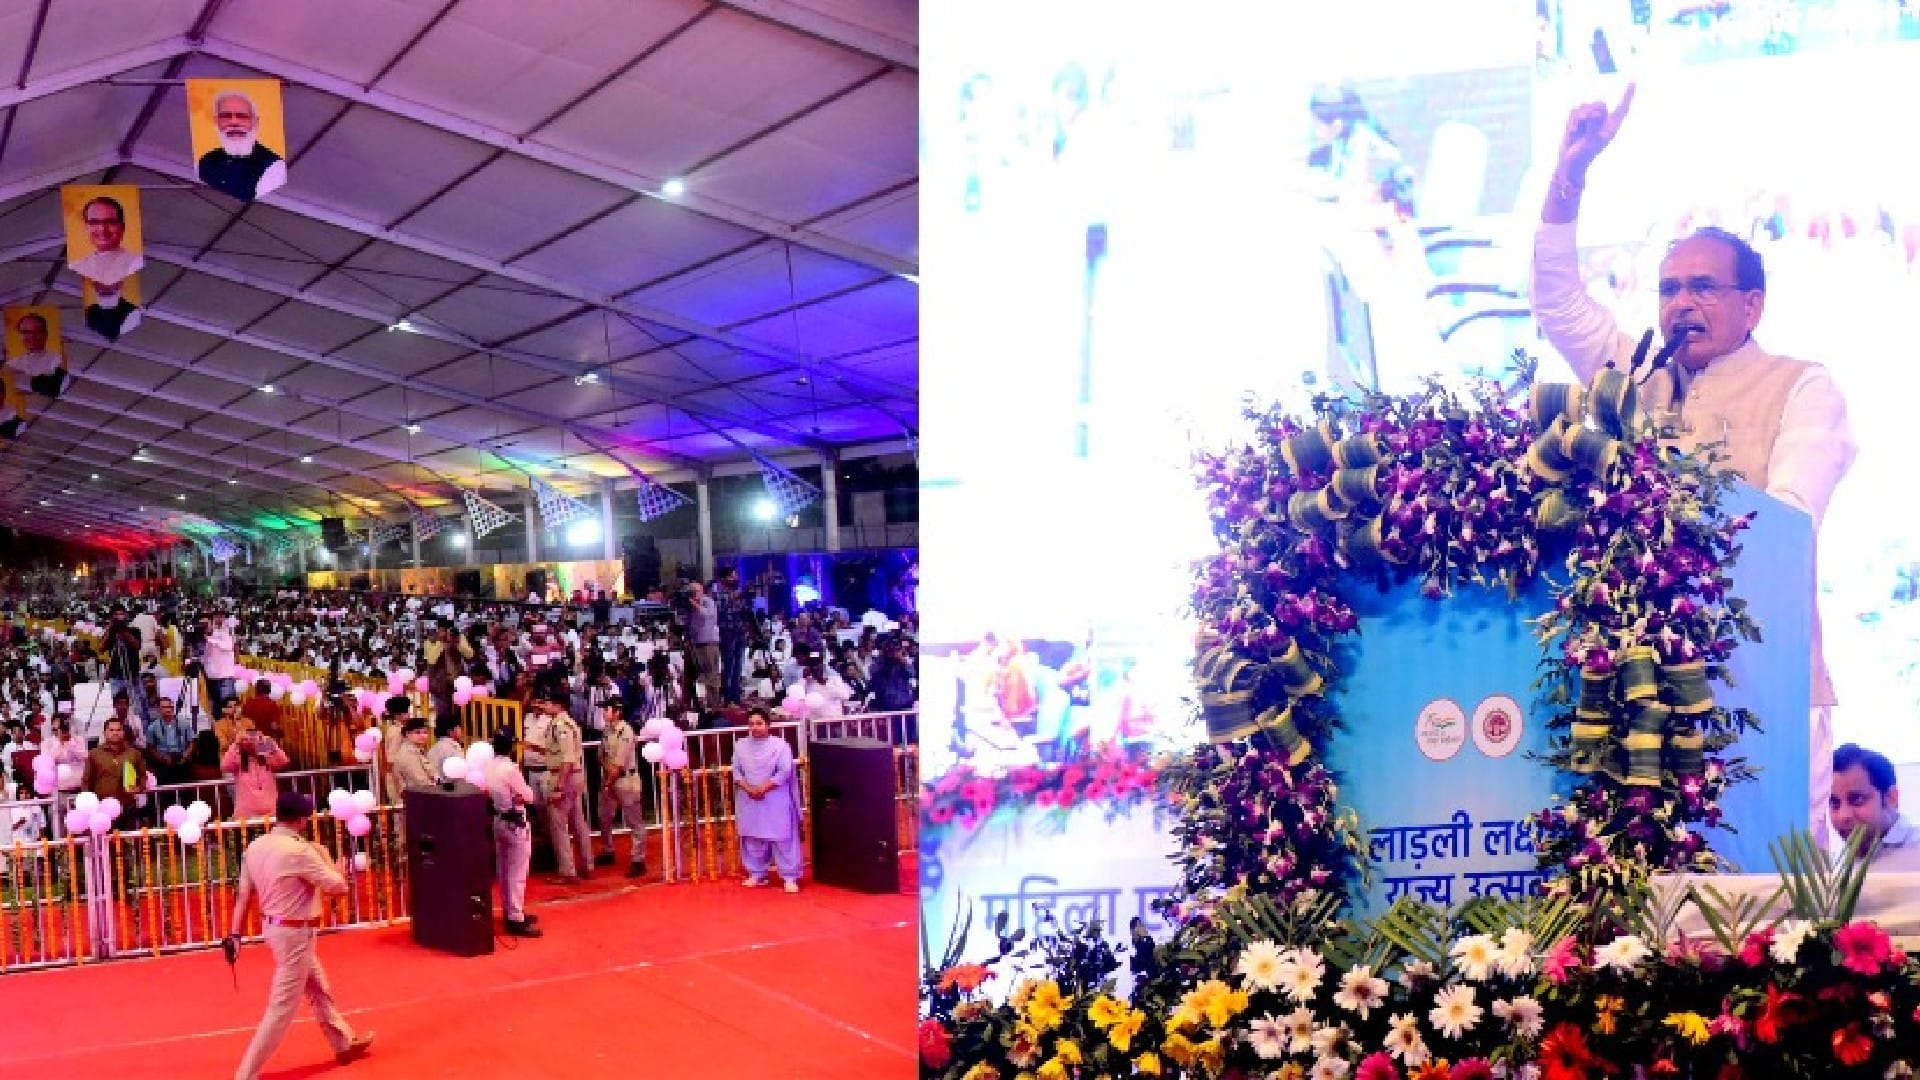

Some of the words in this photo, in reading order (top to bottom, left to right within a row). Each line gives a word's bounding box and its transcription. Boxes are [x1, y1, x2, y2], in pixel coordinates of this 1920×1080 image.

[1367, 810, 1473, 870] लाड़ली
[980, 875, 1122, 944] महिला
[1383, 873, 1456, 908] राज्य
